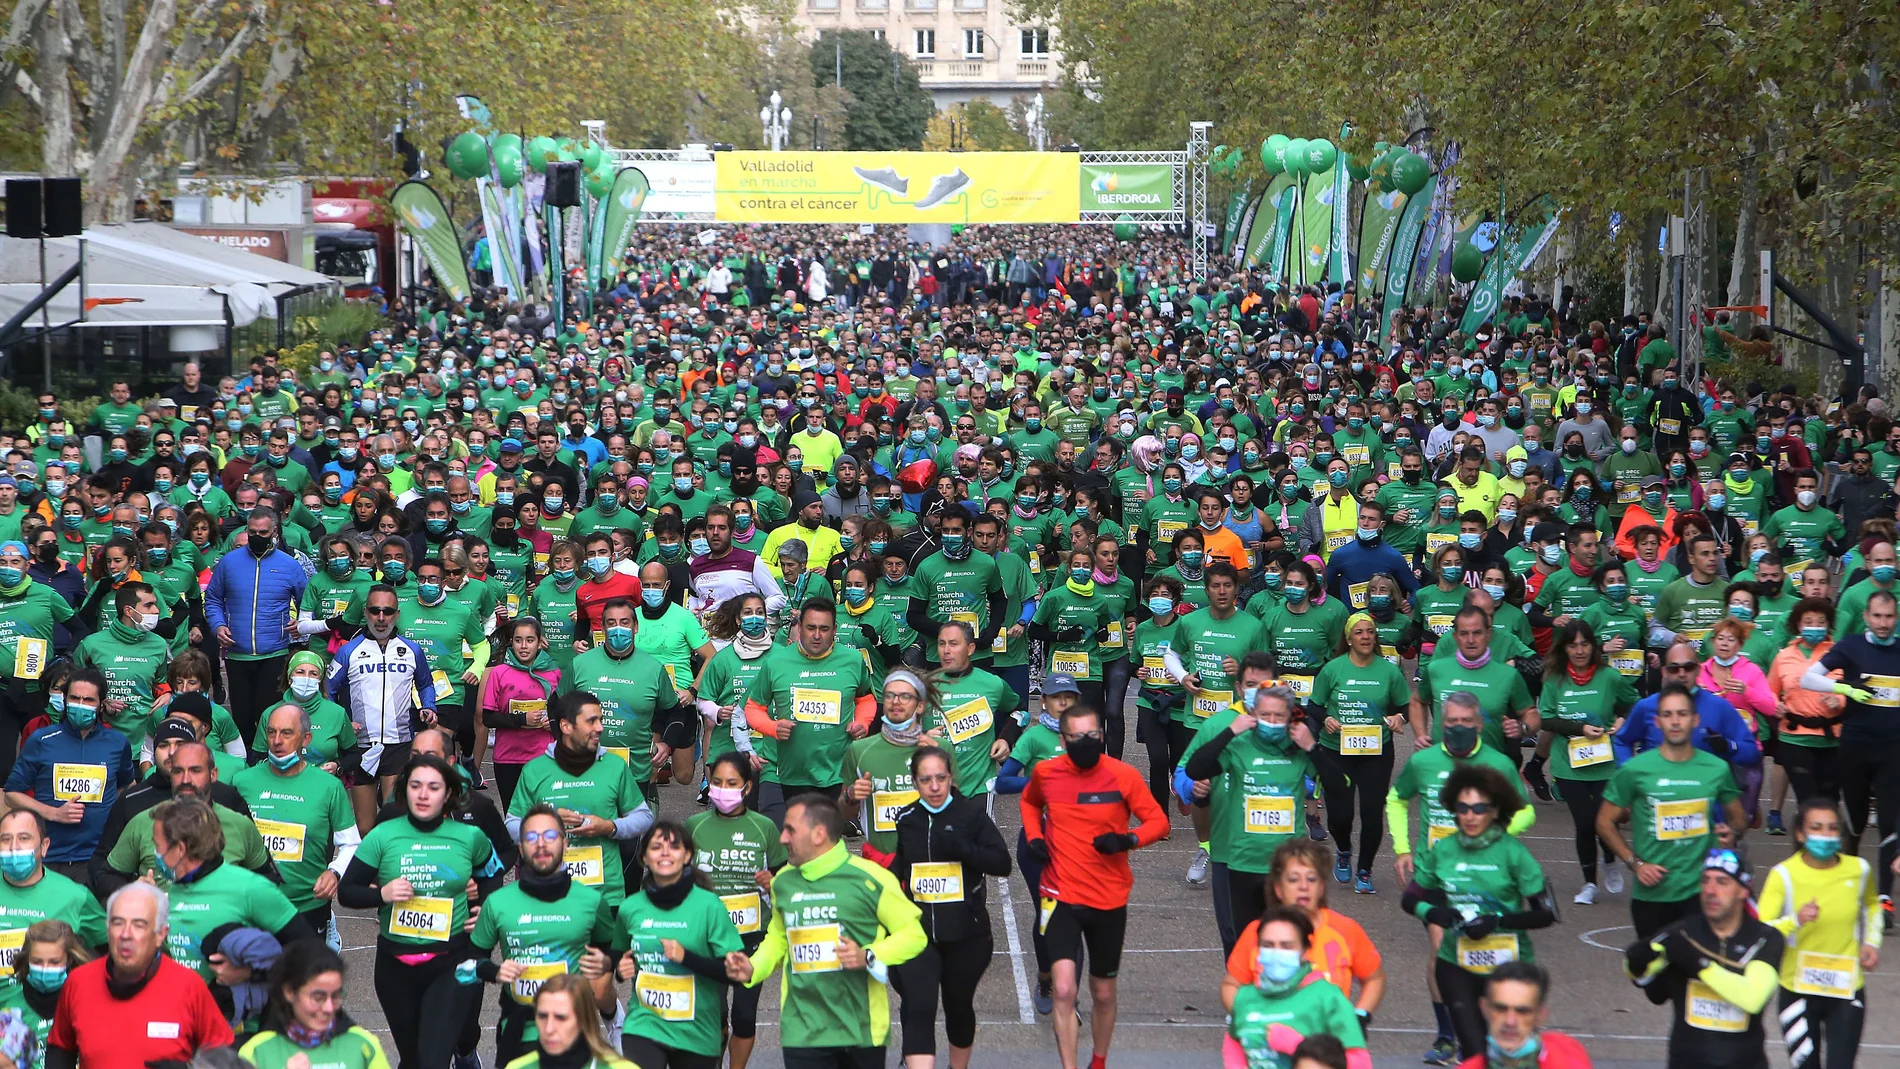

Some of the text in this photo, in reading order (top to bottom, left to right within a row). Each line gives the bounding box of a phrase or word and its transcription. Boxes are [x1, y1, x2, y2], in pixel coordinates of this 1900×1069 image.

[740, 160, 814, 172] Valladolid
[740, 177, 816, 188] en marcha
[740, 197, 858, 210] contra el cáncer
[1098, 194, 1161, 204] IBERDROLA
[219, 236, 270, 248] HELADO
[1370, 216, 1396, 269] IBERDROLA
[948, 605, 971, 613] cáncer
[0, 634, 24, 644] cánce
[26, 653, 39, 674] 9800
[1195, 654, 1222, 662] marcha
[360, 662, 407, 674] IVECO
[1056, 661, 1078, 672] 10055
[105, 670, 116, 678] En
[1202, 668, 1226, 678] cáncer
[115, 694, 142, 702] cáncer
[600, 700, 618, 710] rcha
[798, 700, 826, 716] 24353
[1199, 699, 1217, 712] 1820
[952, 716, 980, 735] 24359
[1346, 716, 1374, 724] cáncer
[1348, 736, 1368, 748] 1819
[564, 780, 595, 788] IBERDROLA
[894, 773, 912, 784] ae
[1244, 774, 1255, 784] En
[58, 778, 90, 794] 14286
[1244, 784, 1278, 793] marcha
[270, 792, 304, 802] IBERDROLA
[1250, 810, 1280, 826] 17169
[400, 854, 412, 864] En
[720, 848, 756, 860] aecc
[400, 864, 438, 874] marcha
[916, 878, 947, 894] 49907
[7, 908, 46, 918] IBERDROLA
[532, 914, 571, 922] IBERDROLA
[728, 910, 744, 926] 06
[802, 906, 838, 920] aecc
[398, 910, 434, 930] 45064
[652, 920, 688, 929] IBERDROLA
[506, 936, 520, 946] En
[510, 945, 550, 956] marcha
[794, 944, 821, 962] 14759
[519, 979, 539, 997] 720
[646, 990, 672, 1010] 7203
